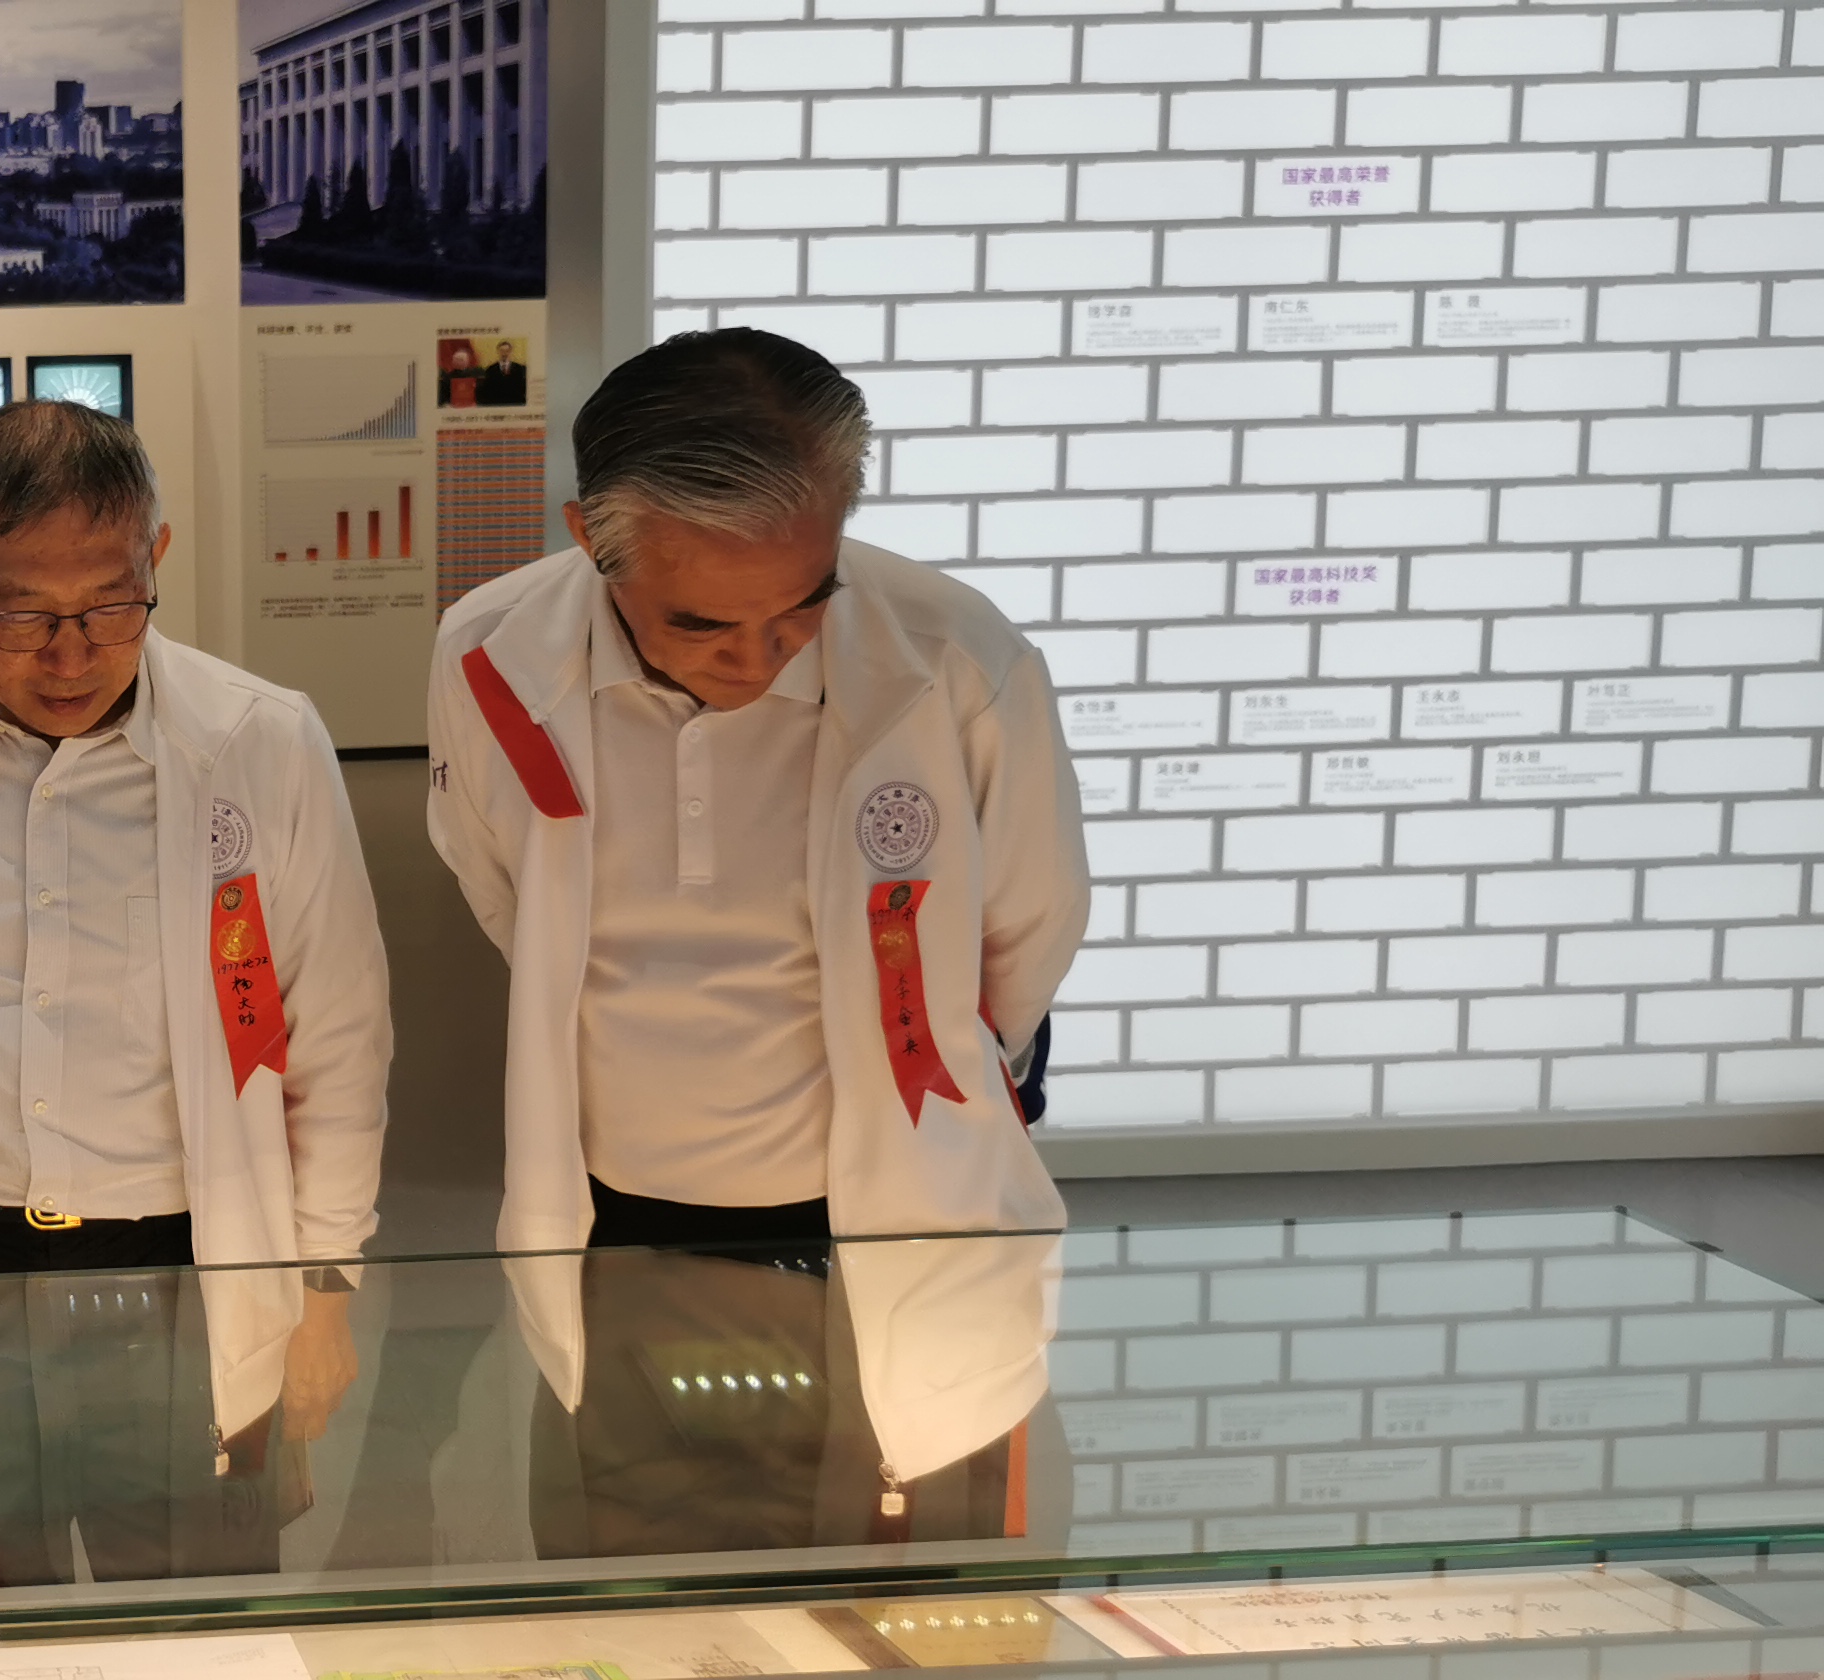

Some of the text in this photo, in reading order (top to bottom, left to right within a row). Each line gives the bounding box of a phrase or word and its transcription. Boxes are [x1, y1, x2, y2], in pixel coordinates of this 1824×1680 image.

[1282, 166, 1389, 185] 国家最高荣誉
[1309, 190, 1360, 207] 获得者
[1255, 566, 1376, 585] 国家最高科技奖
[1289, 589, 1339, 605] 获得者
